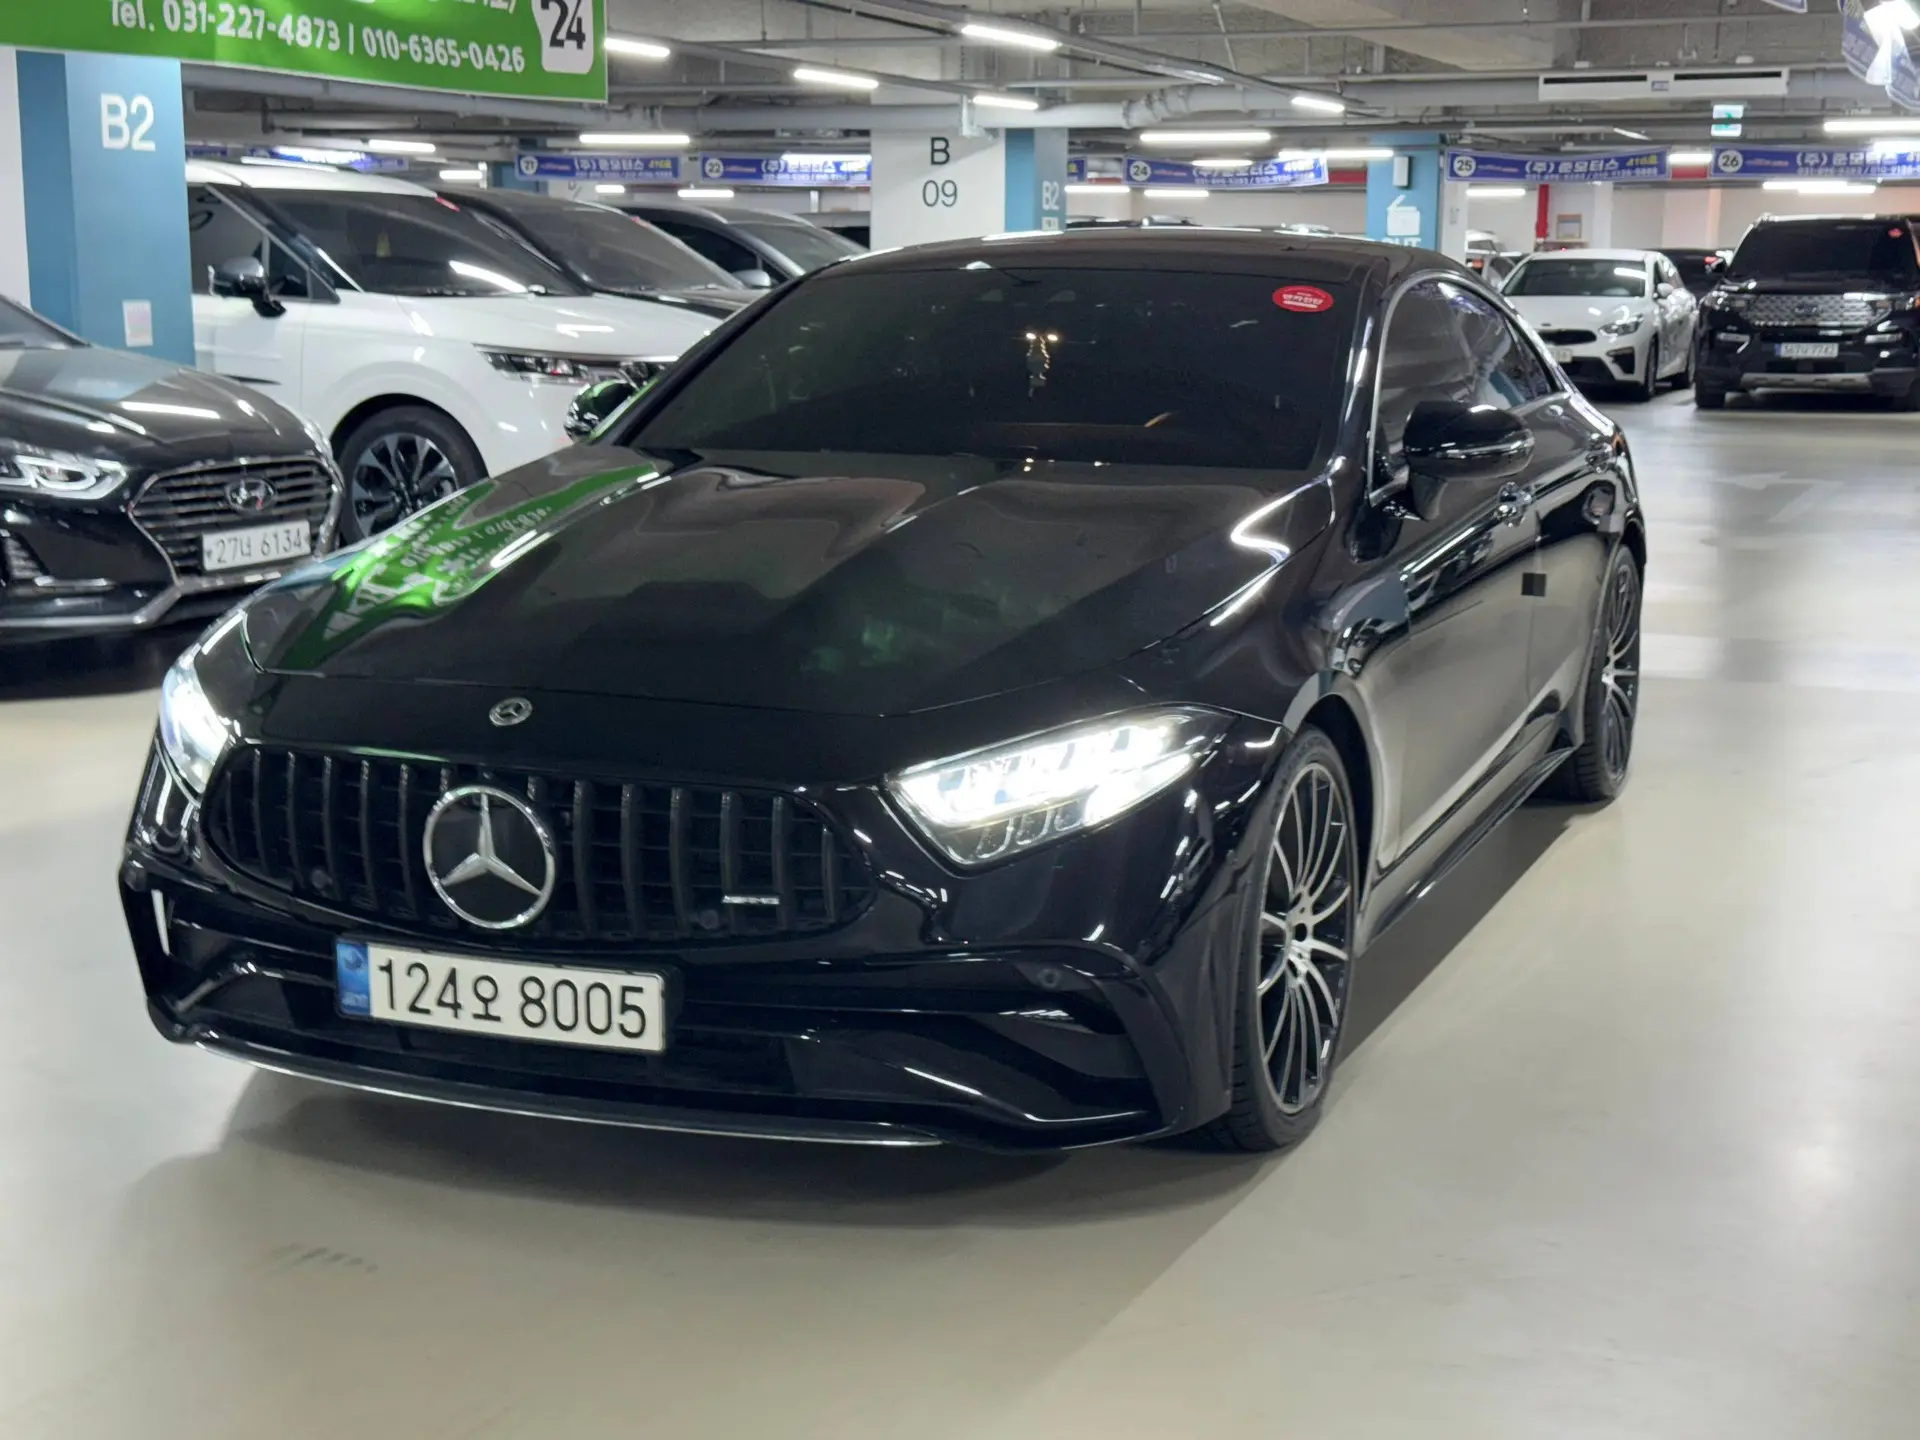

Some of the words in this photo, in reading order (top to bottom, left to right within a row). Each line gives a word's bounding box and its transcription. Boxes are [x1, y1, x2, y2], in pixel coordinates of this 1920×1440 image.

[111, 0, 155, 32] Tel.
[163, 0, 340, 51] 031-227-4873
[362, 26, 525, 73] 010-6365-0426
[540, 0, 586, 49] 24
[100, 92, 156, 151] B2
[930, 137, 950, 165] B
[1456, 159, 1473, 172] 25
[1721, 154, 1739, 167] 26
[708, 162, 721, 174] 22
[1132, 164, 1148, 177] 24
[922, 180, 958, 208] 09
[1042, 181, 1059, 211] B2
[261, 527, 302, 557] 6134
[378, 958, 503, 1023] 124오
[519, 975, 647, 1039] 8005
